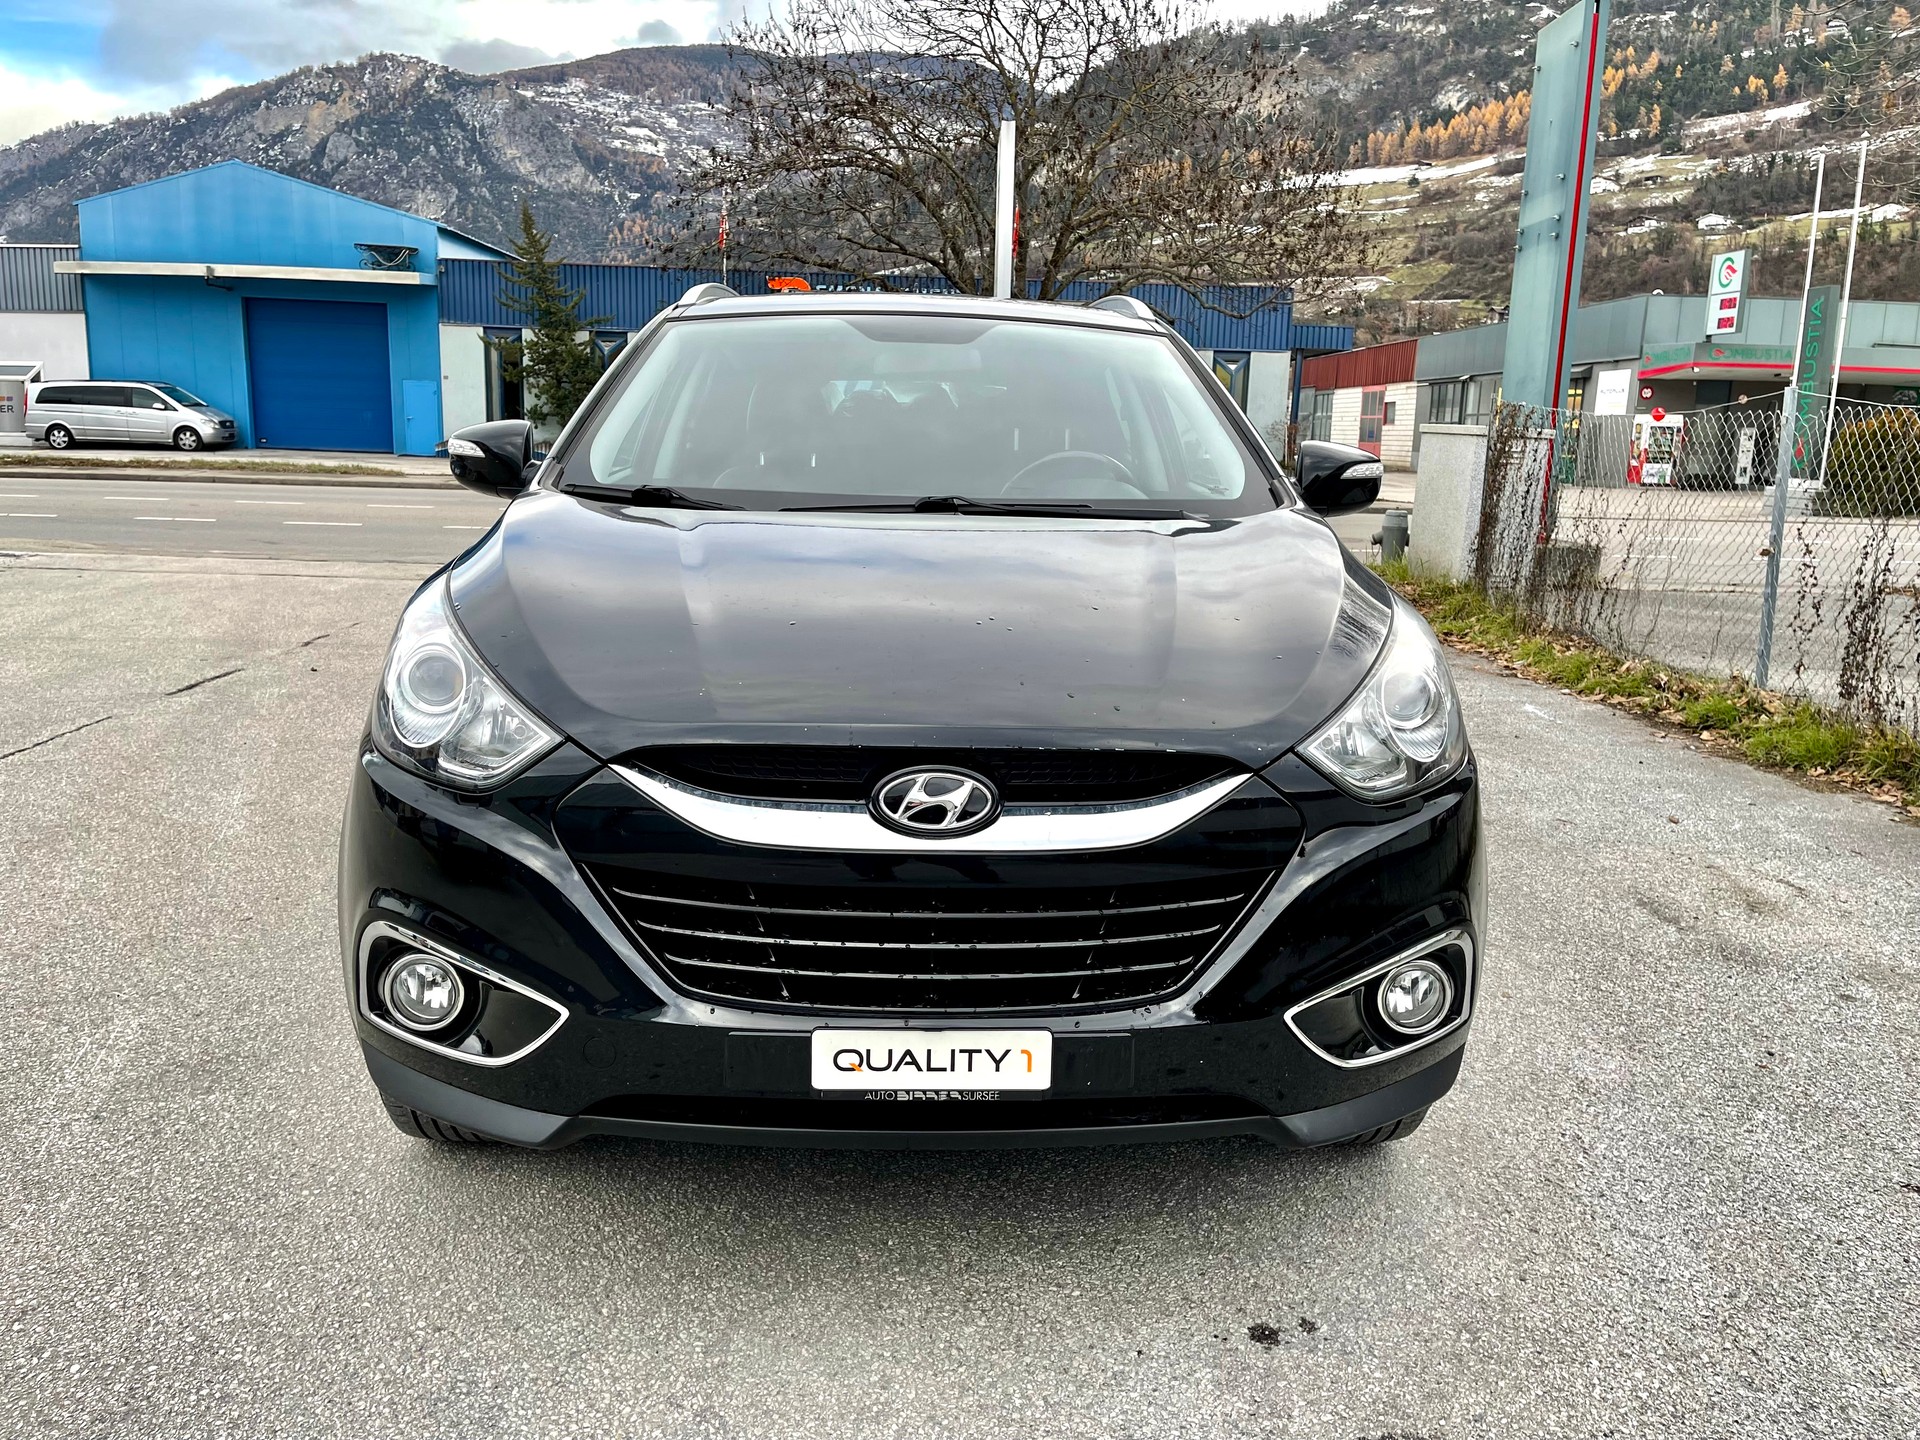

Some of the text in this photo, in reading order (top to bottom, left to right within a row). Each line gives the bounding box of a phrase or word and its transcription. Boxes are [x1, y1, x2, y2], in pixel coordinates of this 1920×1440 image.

[833, 1049, 1032, 1072] QUALITY 1
[864, 1090, 895, 1101] AUTO
[962, 1090, 1000, 1101] SURSEE
